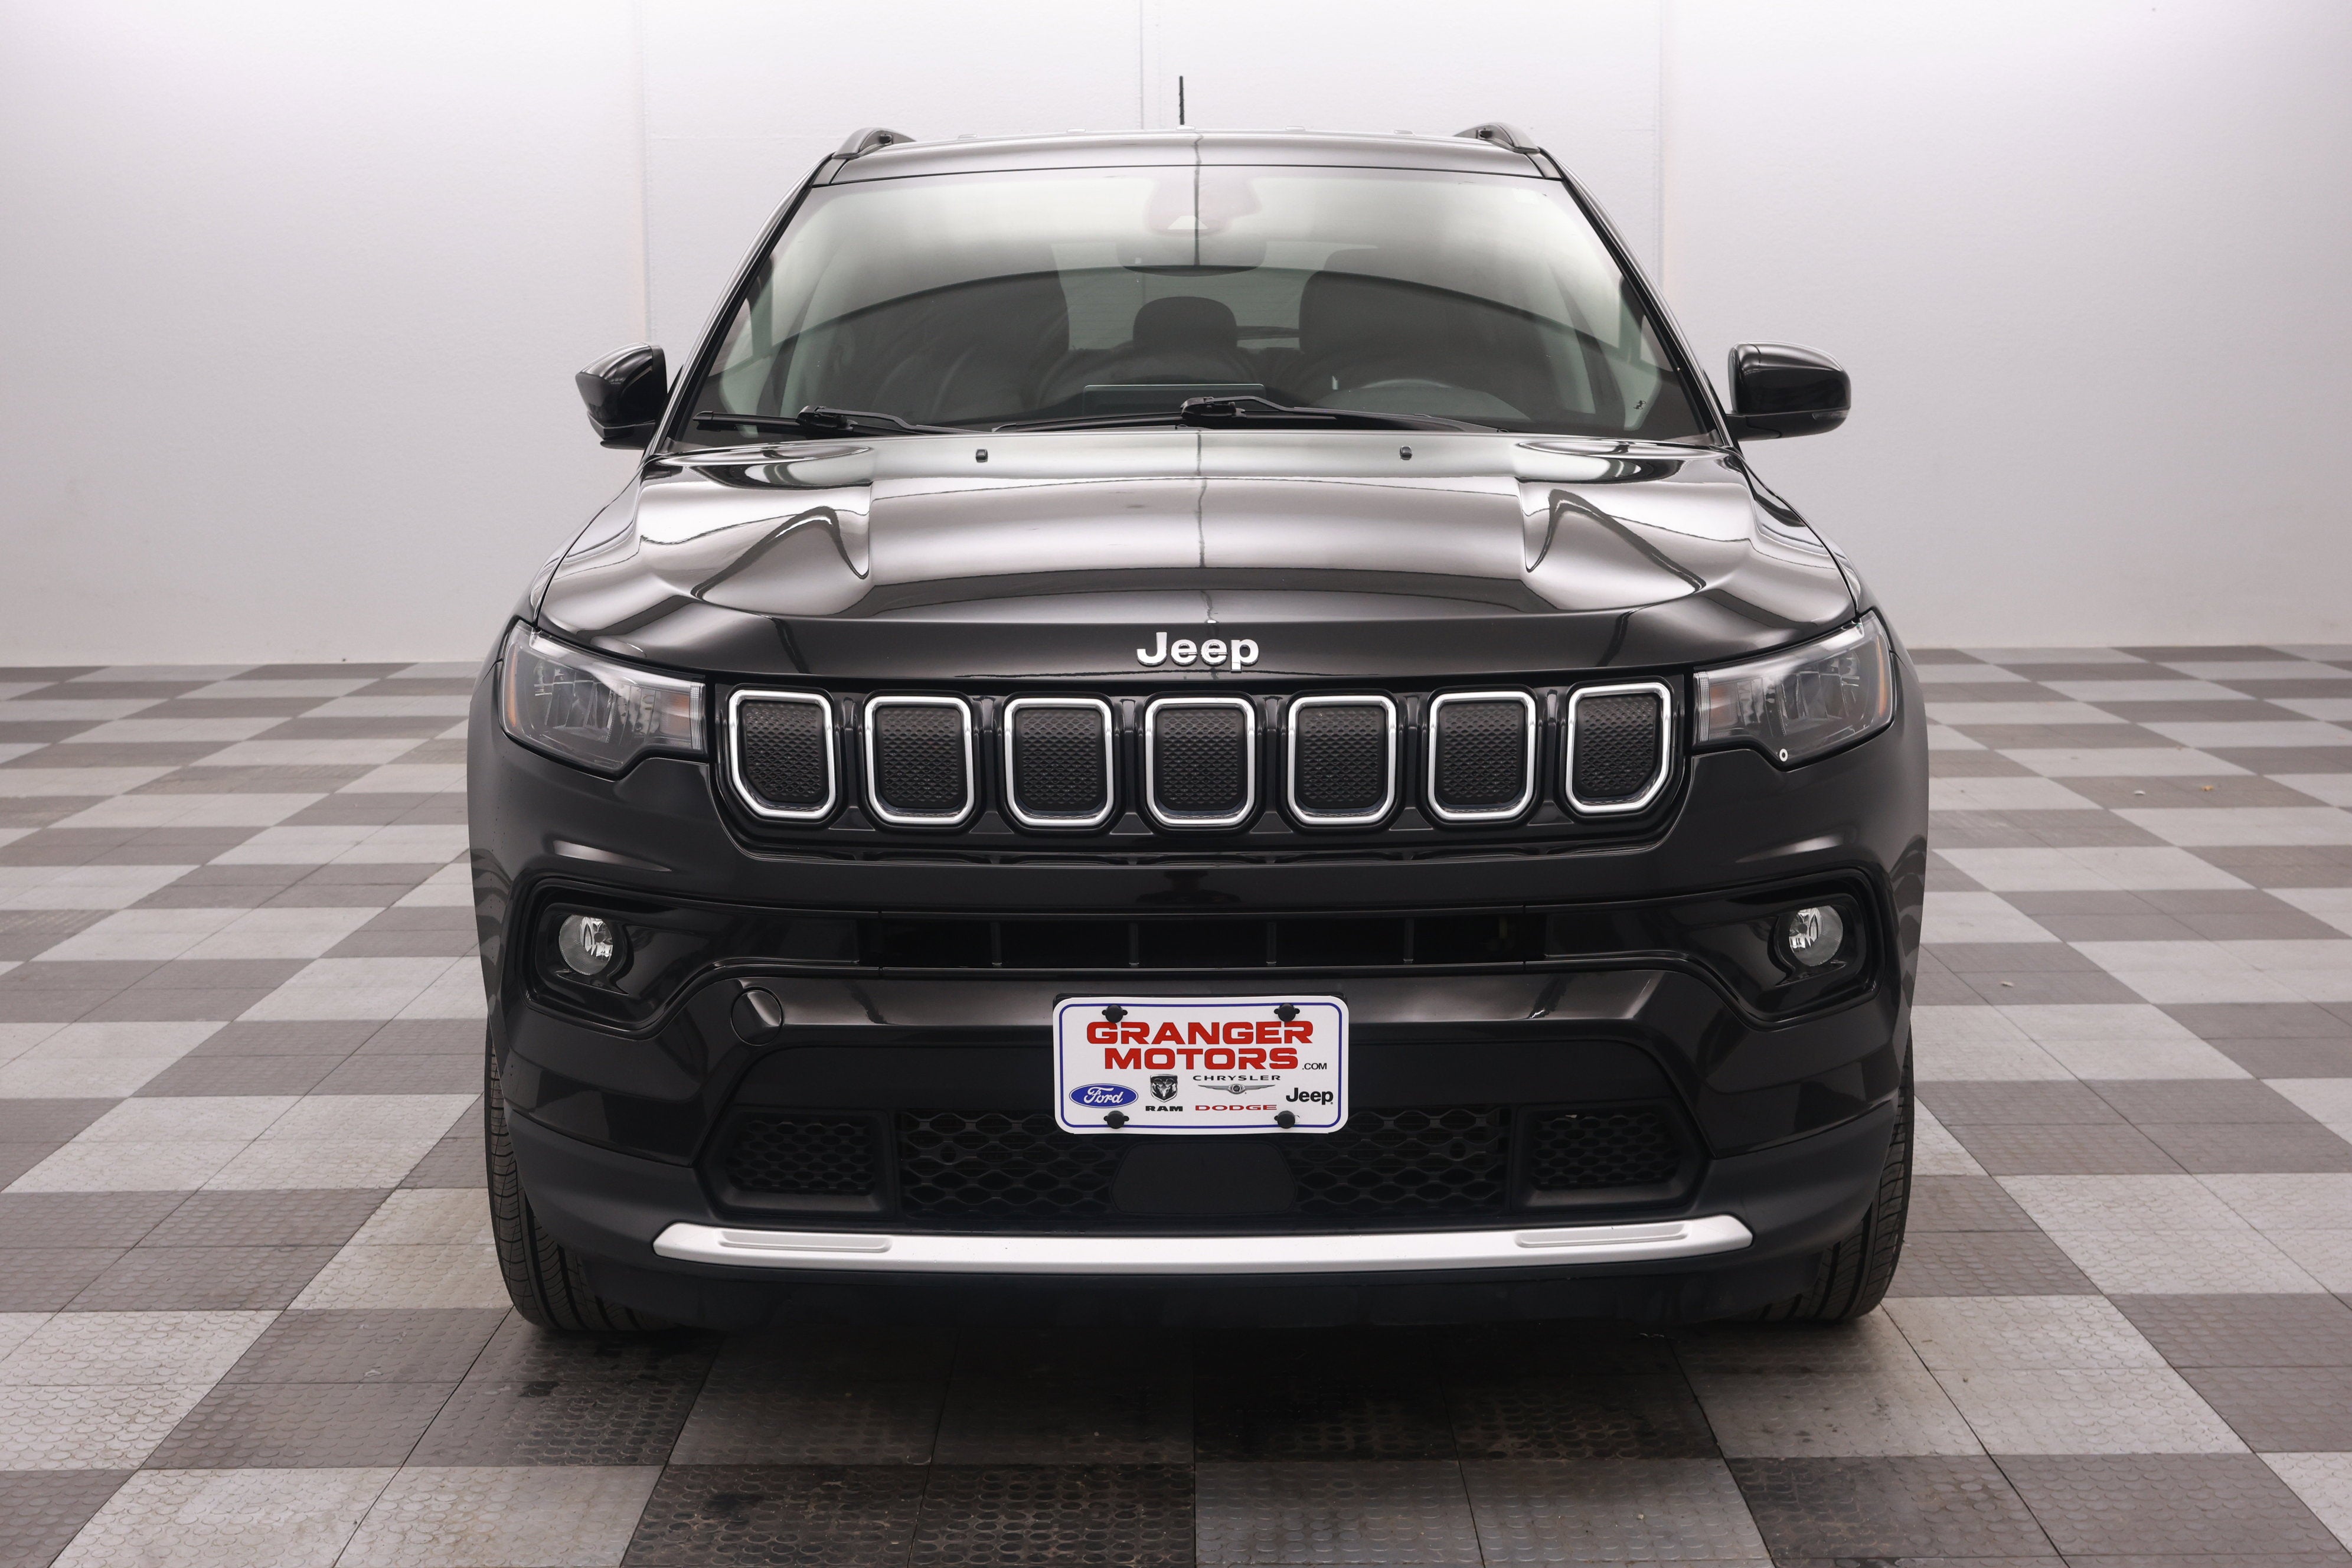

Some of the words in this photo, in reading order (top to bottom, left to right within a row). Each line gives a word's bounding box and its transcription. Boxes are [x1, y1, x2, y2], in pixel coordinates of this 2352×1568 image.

[1136, 632, 1259, 672] Jeep
[1086, 1021, 1314, 1044] GRANGER
[1105, 1047, 1299, 1070] MOTORS
[1083, 1086, 1123, 1104] Ford
[1285, 1087, 1334, 1105] Jeep
